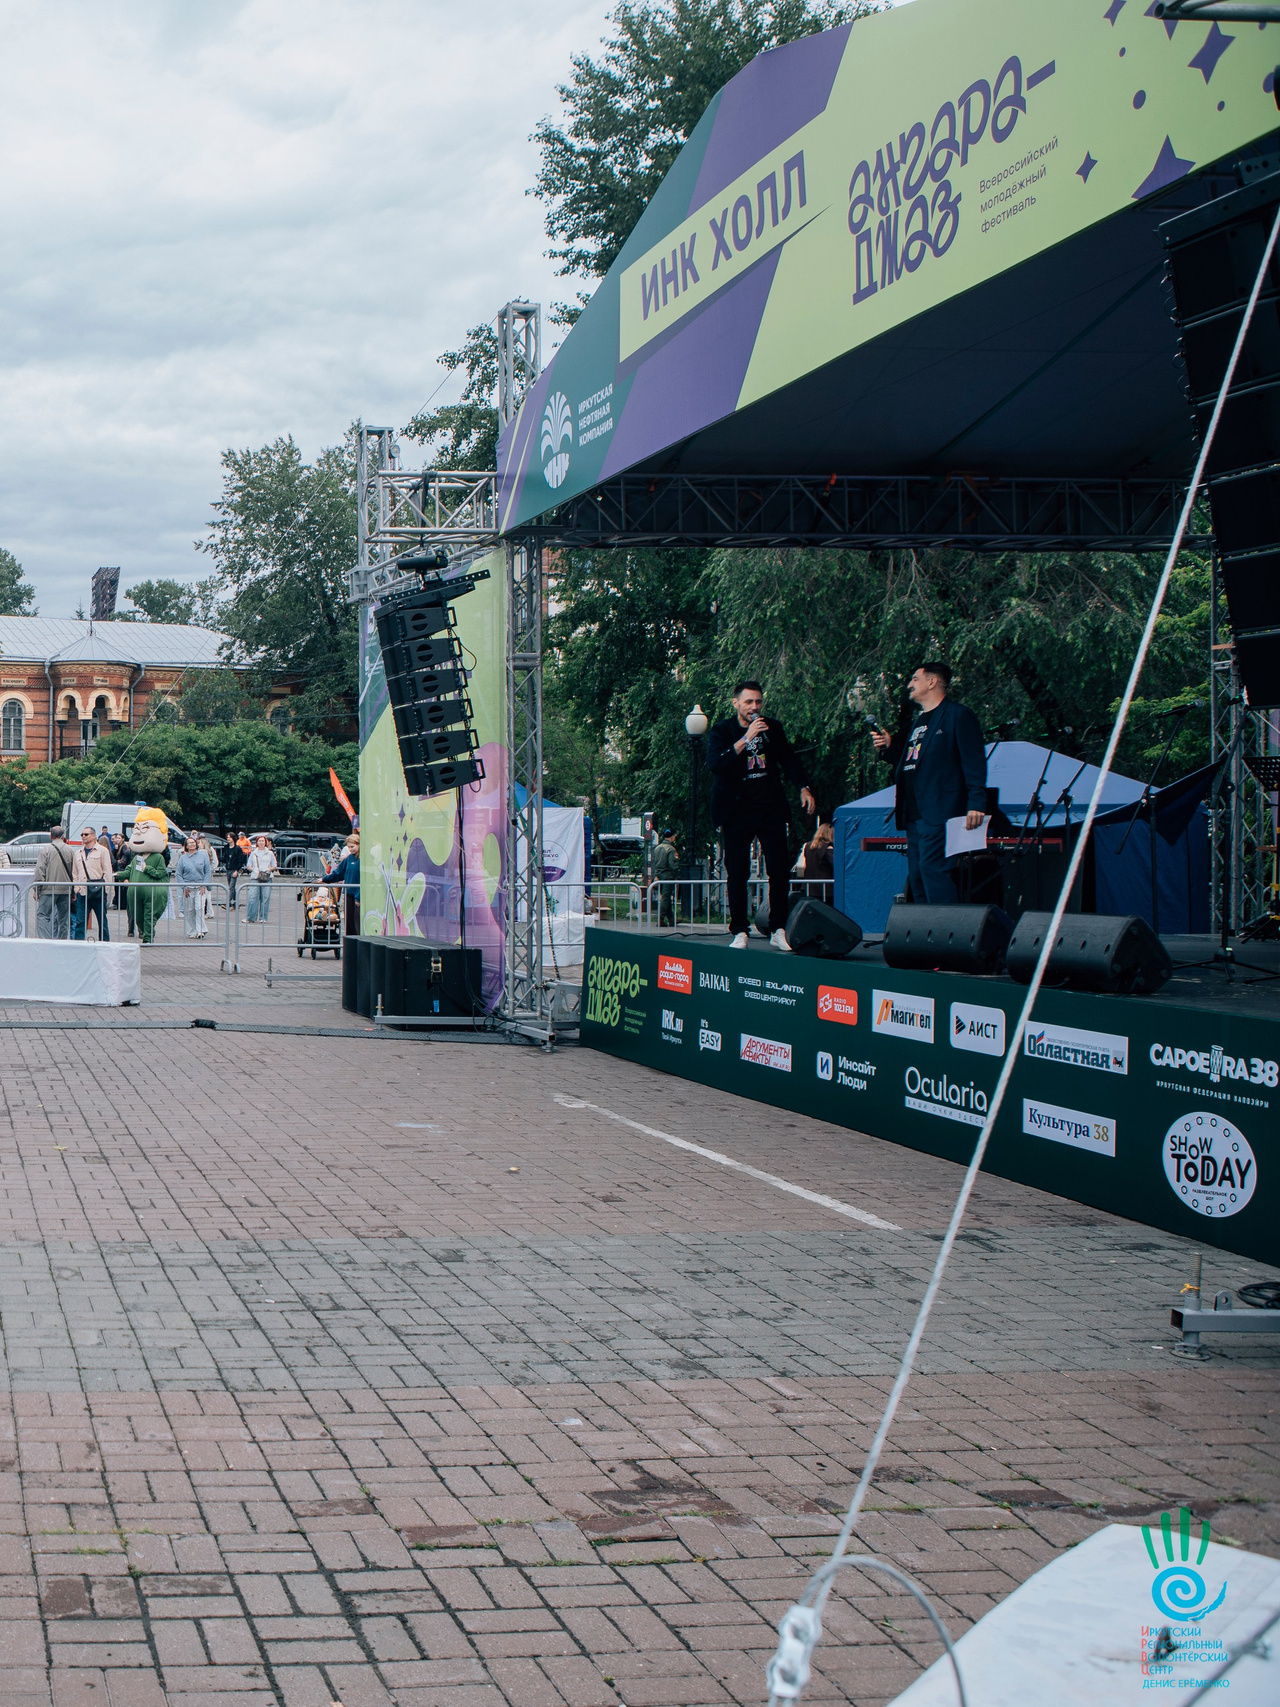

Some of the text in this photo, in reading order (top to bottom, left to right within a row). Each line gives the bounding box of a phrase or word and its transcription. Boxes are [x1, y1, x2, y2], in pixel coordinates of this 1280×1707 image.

[979, 135, 1059, 194] Всероссийский
[980, 164, 1047, 214] молодёжный
[981, 195, 1037, 235] фестиваль
[641, 149, 807, 321] ИНК ХОЛЛ
[852, 179, 962, 306] джаз
[578, 382, 613, 415] ИРКУТСКАЯ
[578, 402, 611, 431] НЕФТЯНАЯ
[578, 417, 613, 447] КОМПАНИЯ
[699, 971, 730, 993] BAIKAL
[738, 976, 761, 987] EXEED
[765, 981, 804, 994] EXLANTIX
[744, 990, 760, 1000] EXEED
[761, 994, 778, 1002] ЦЕНТР
[661, 1009, 684, 1033] IRK.RU
[845, 1005, 854, 1015] FM
[700, 1031, 720, 1049] EASY
[968, 1020, 998, 1040] АИСТ
[744, 1037, 791, 1060] АРГУМЕНТЫ
[746, 1050, 771, 1065] ФАКТЫ
[838, 1055, 877, 1077] Инсайт
[837, 1071, 867, 1091] Люди
[905, 1066, 988, 1112] Ocularia
[1156, 1080, 1191, 1093] ИРКУТСКАЯ
[1192, 1087, 1231, 1101] ФЕДЕРАЦИЯ
[1028, 1107, 1109, 1143] Культура 38
